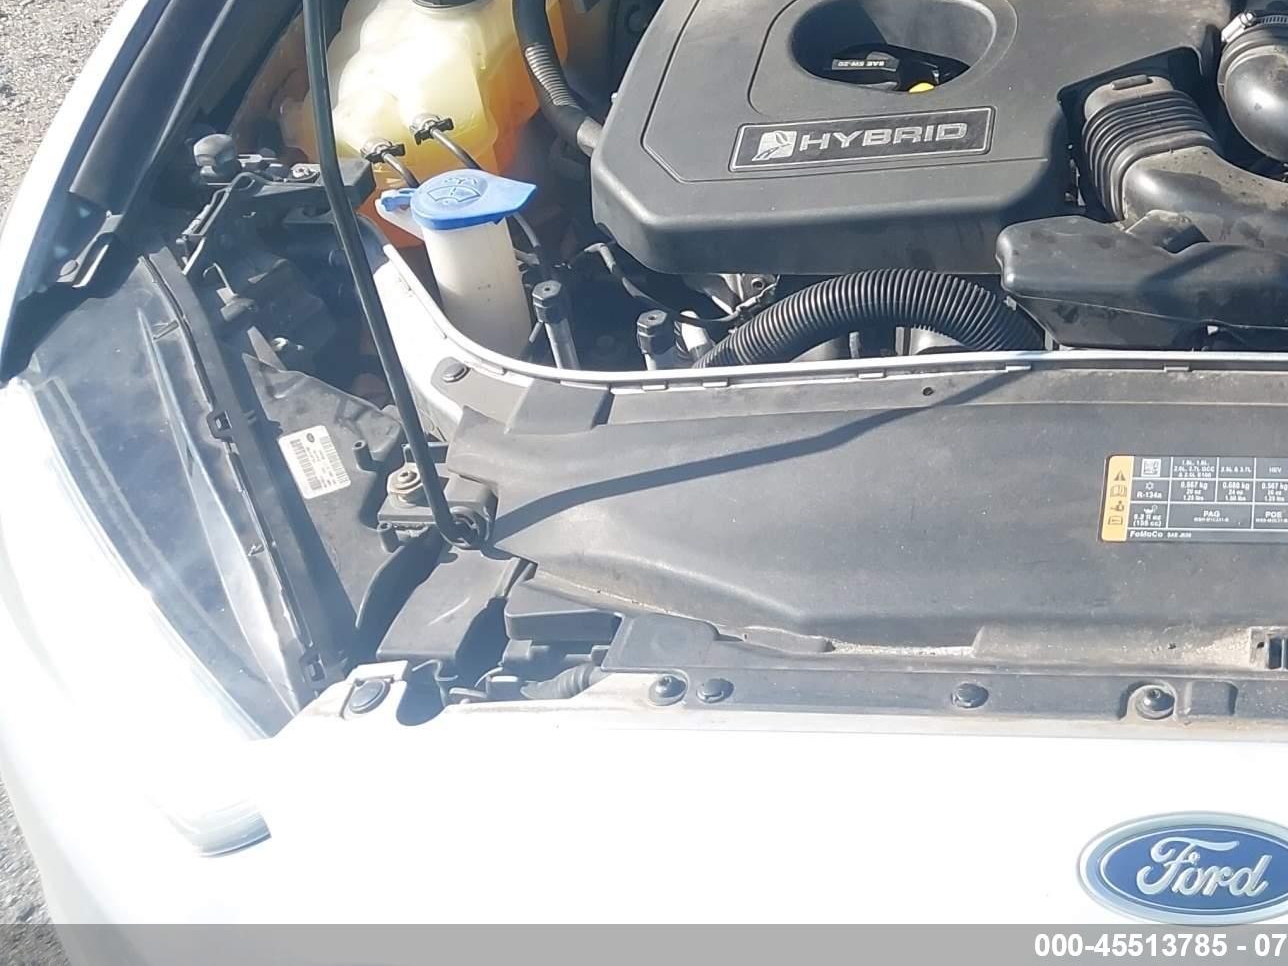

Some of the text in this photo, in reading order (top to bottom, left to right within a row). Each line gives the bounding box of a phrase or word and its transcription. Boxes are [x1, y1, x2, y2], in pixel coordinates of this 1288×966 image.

[799, 122, 968, 152] HYBRID
[1199, 481, 1208, 490] kg
[1241, 482, 1250, 490] kg
[1279, 482, 1288, 491] kg
[1136, 490, 1163, 499] R-134a
[1265, 510, 1282, 518] POE
[1129, 530, 1164, 538] FoMoCo
[1136, 836, 1273, 897] Ford
